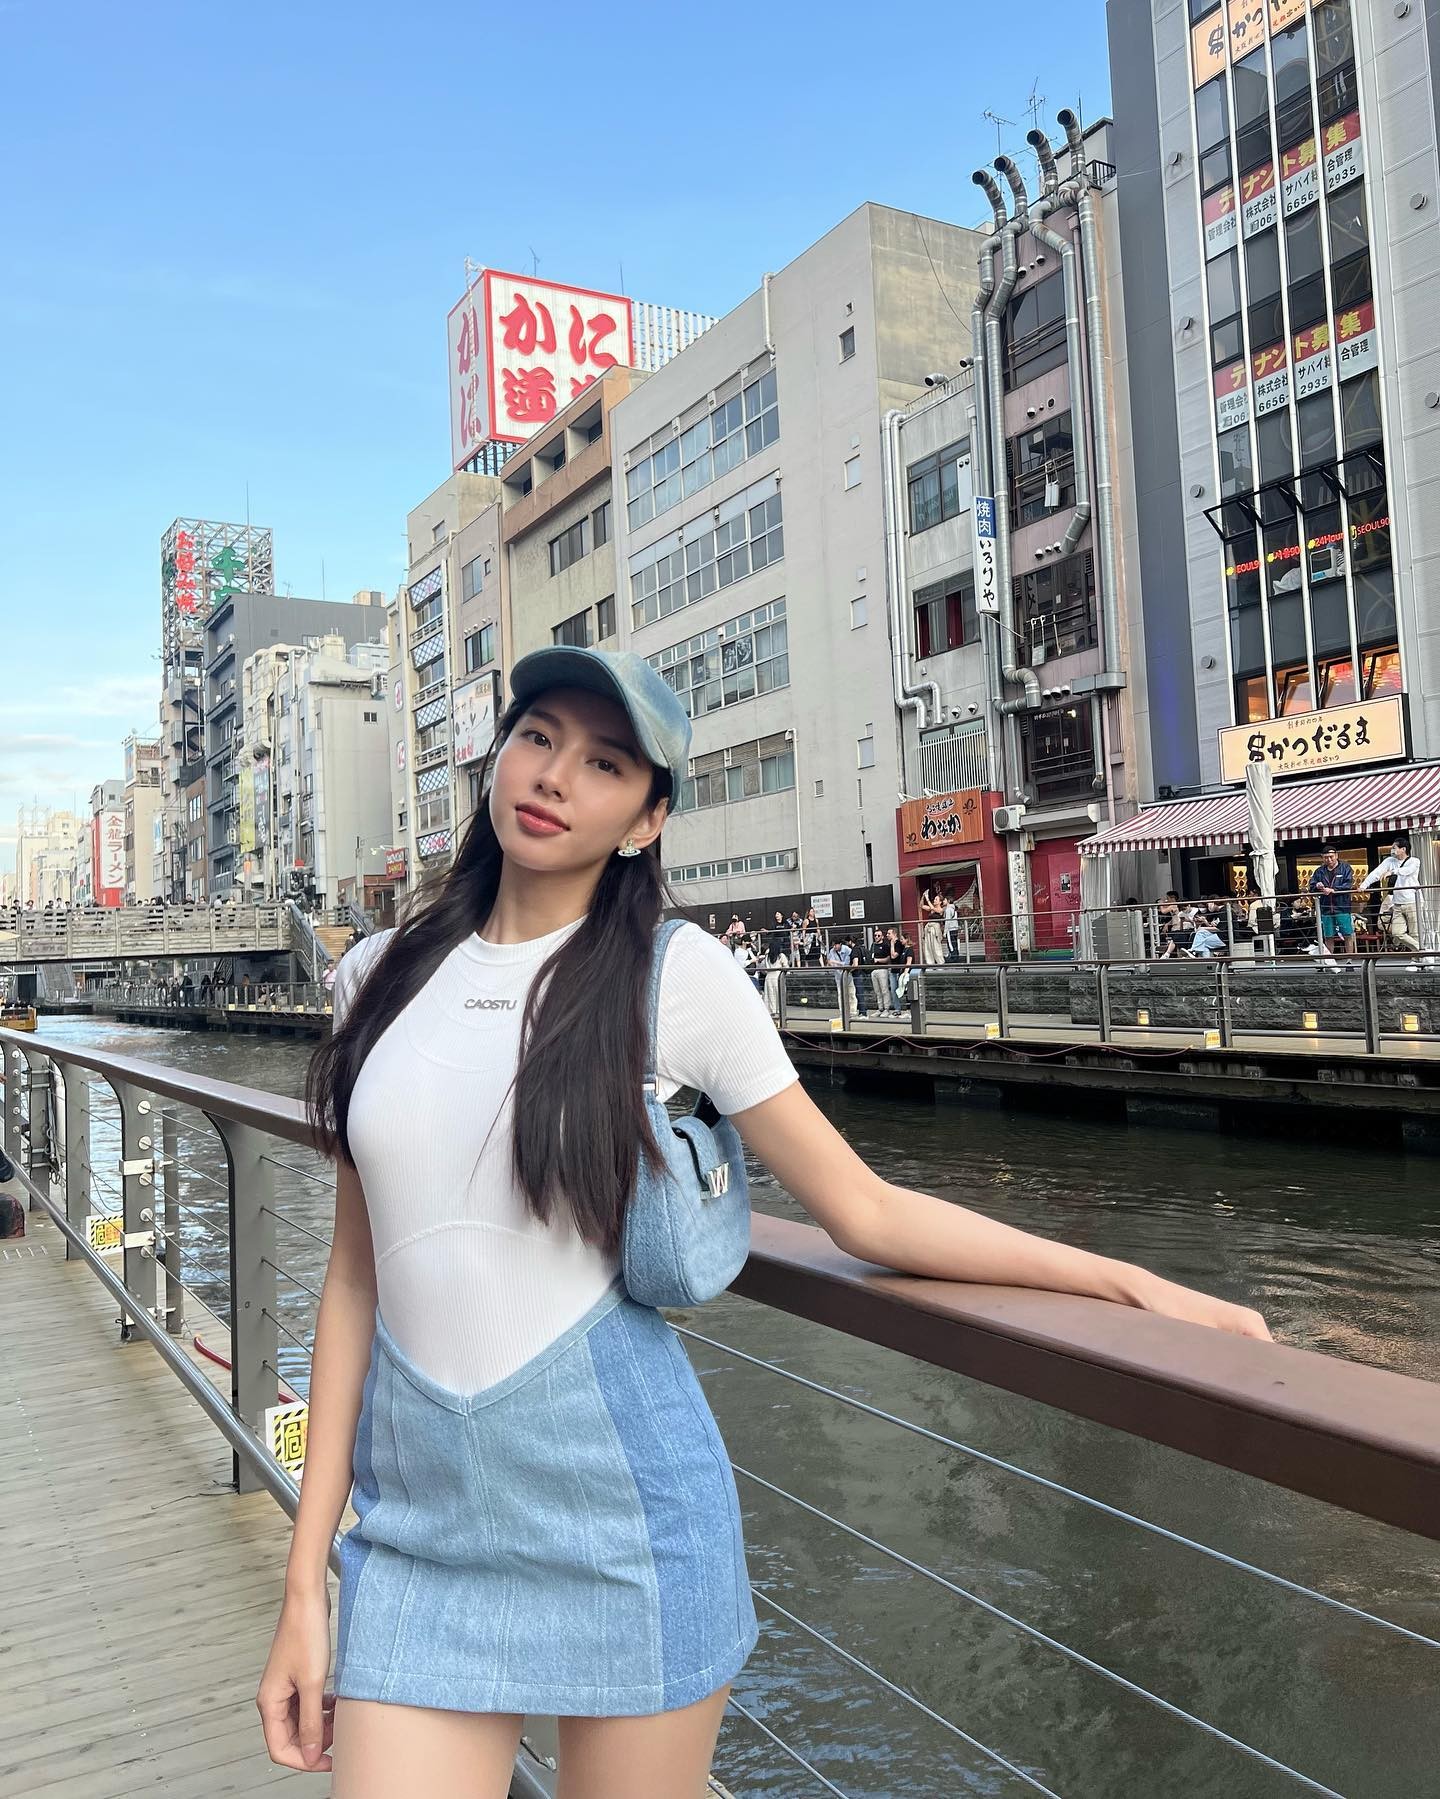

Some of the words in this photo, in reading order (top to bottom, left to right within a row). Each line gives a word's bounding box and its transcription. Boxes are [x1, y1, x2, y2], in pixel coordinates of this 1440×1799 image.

[1218, 121, 1347, 213] テナント募集
[500, 293, 619, 367] かに
[1231, 311, 1362, 389] テナント募集
[977, 500, 992, 536] 焼肉
[979, 540, 995, 608] いろりや
[1247, 716, 1371, 763] 串かつだるま
[921, 814, 962, 840] わなか
[464, 998, 518, 1011] CAOSTU
